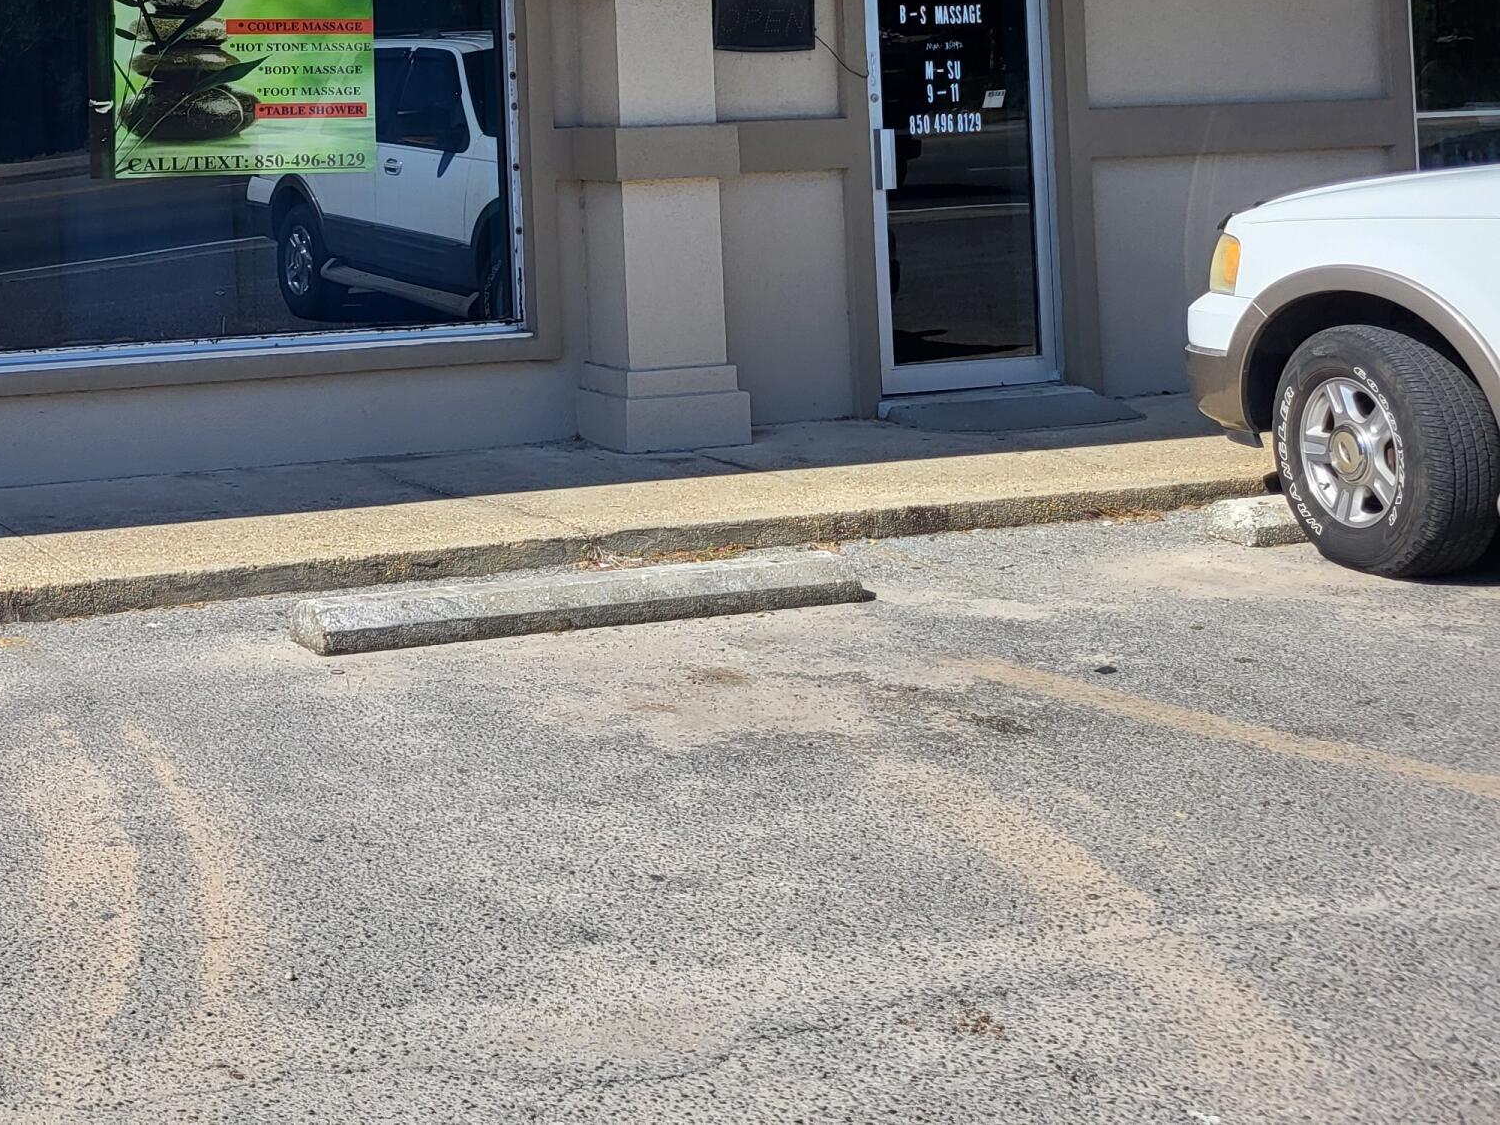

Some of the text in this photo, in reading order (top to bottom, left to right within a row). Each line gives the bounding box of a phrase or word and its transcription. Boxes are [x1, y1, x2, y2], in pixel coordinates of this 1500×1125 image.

[722, 7, 807, 36] OPEN
[935, 4, 982, 24] MASSAGE
[247, 22, 363, 32] COUPLE MASSAGE
[266, 42, 308, 52] STONE
[311, 42, 372, 52] MASSAGE
[302, 65, 363, 75] MASSAGE
[301, 86, 361, 96] MASSAGE
[308, 105, 363, 115] SHOWER
[909, 112, 982, 135] 850 496 8129
[127, 153, 366, 172] CALL/TEXT: 850-496-8129
[1353, 366, 1405, 526] GOODYEAR
[1278, 386, 1323, 535] WRANGLER
